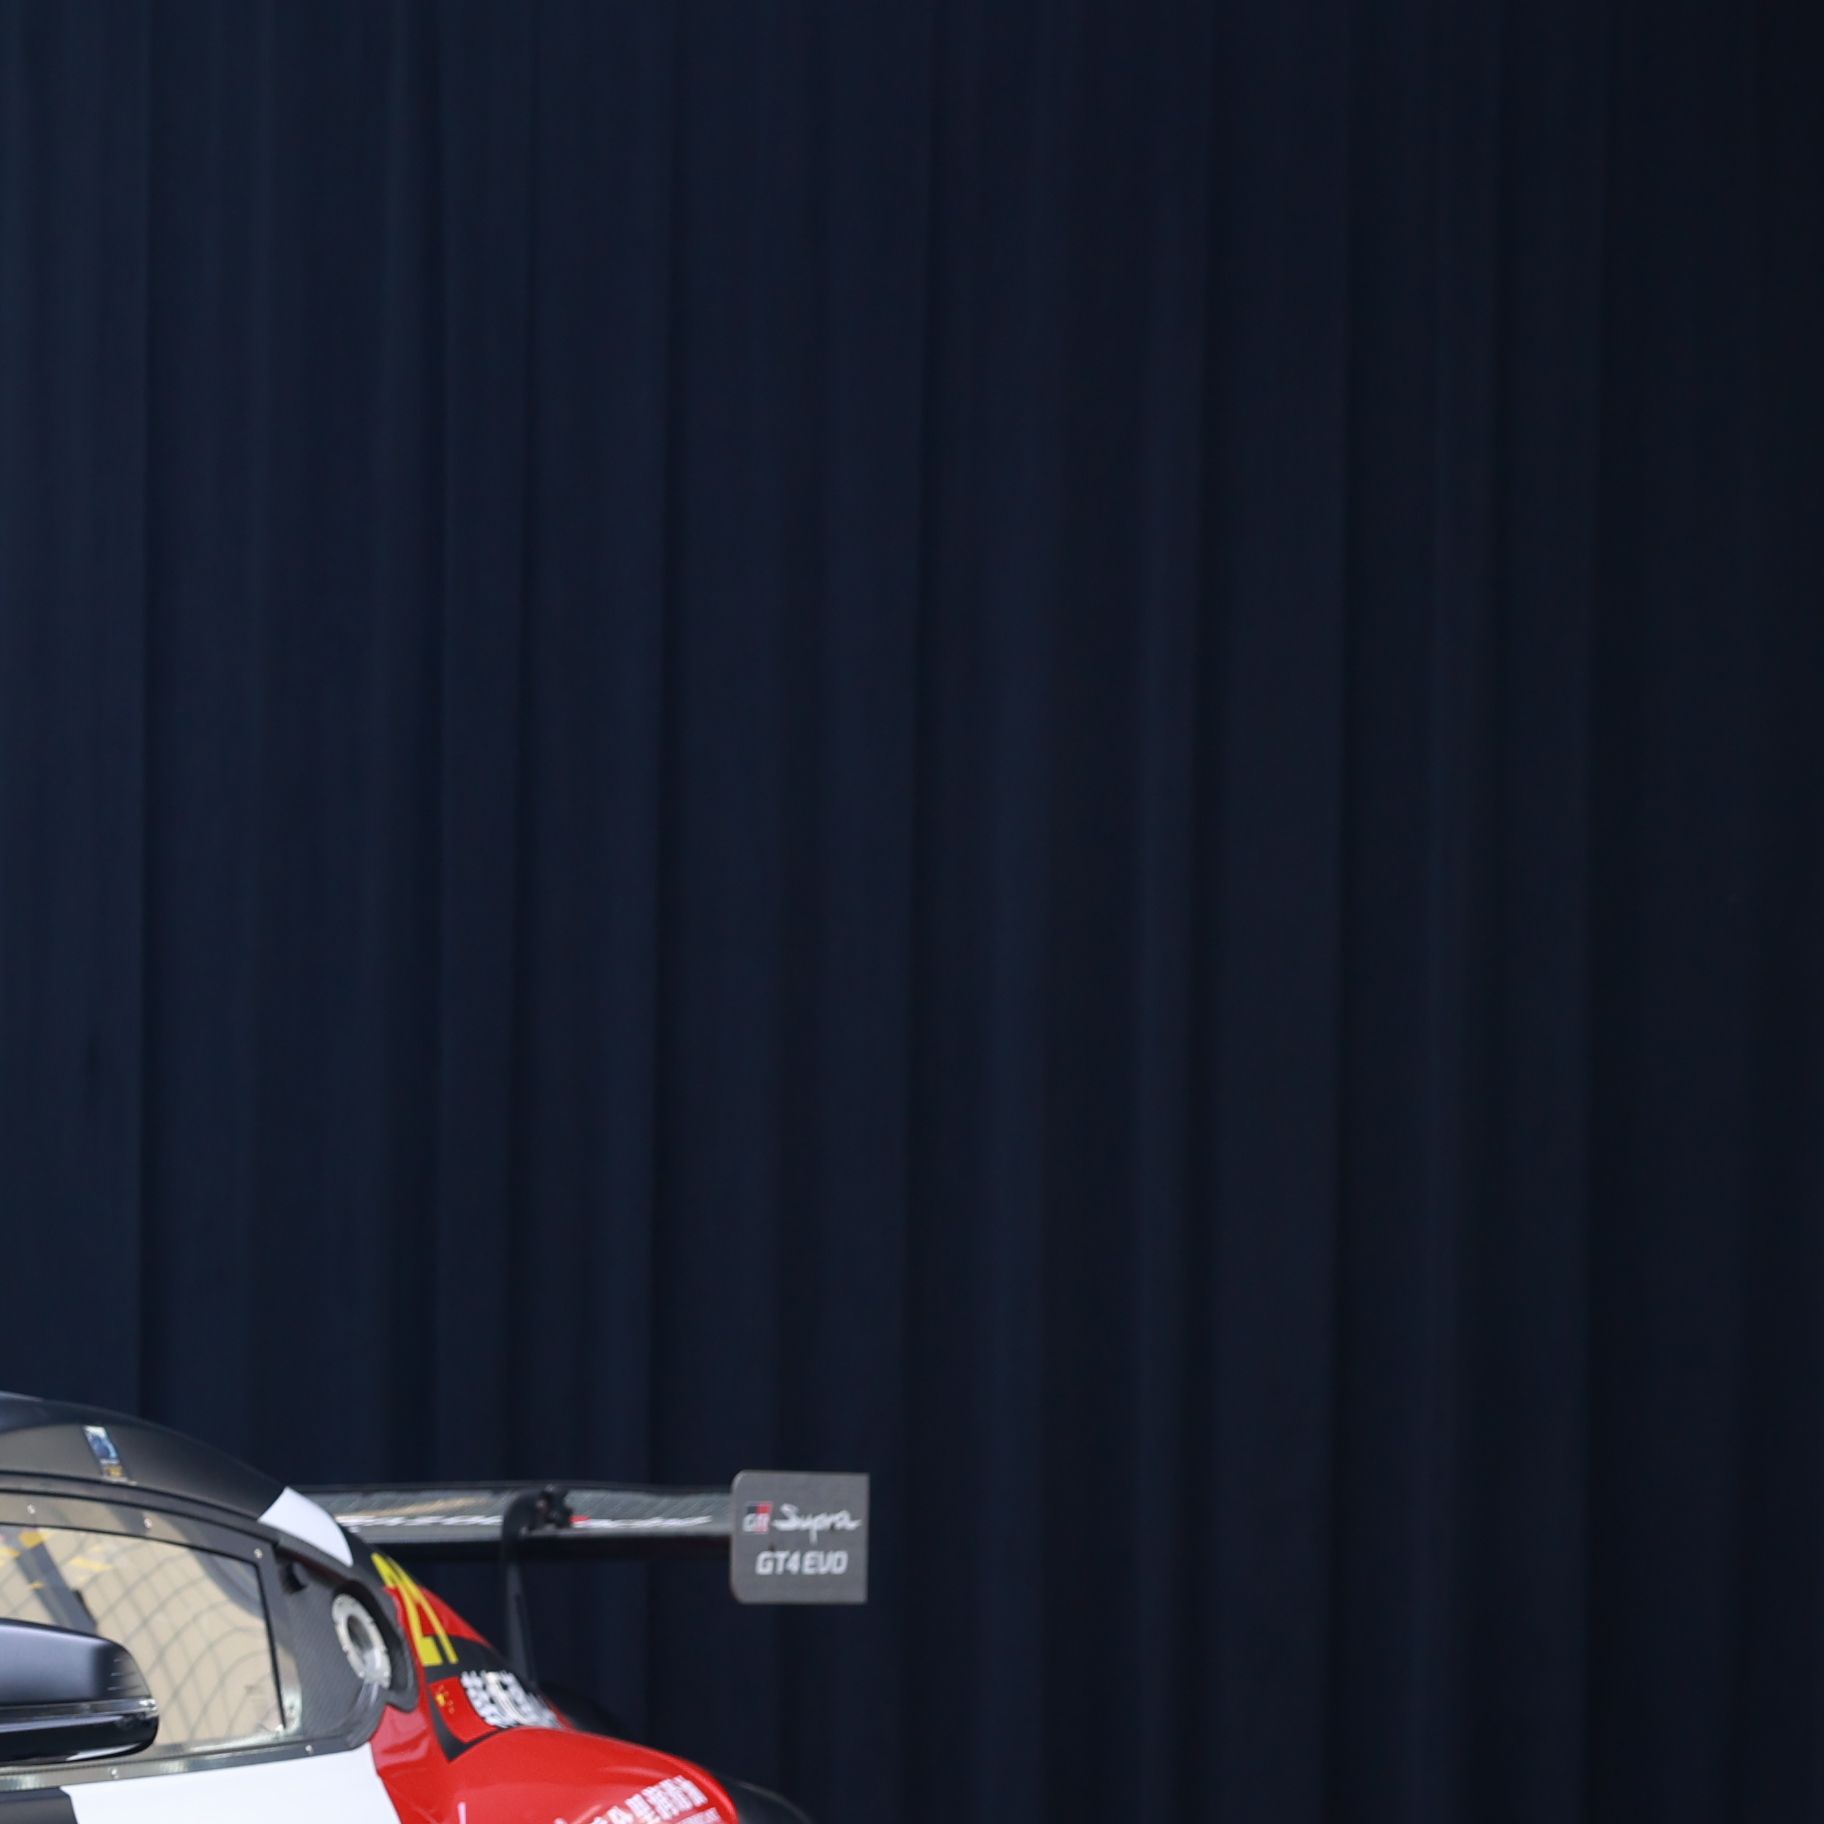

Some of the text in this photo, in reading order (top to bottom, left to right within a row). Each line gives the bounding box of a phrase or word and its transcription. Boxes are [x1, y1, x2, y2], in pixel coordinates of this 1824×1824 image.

[772, 1503, 862, 1545] Supra
[755, 1550, 849, 1575] GT4 EVO
